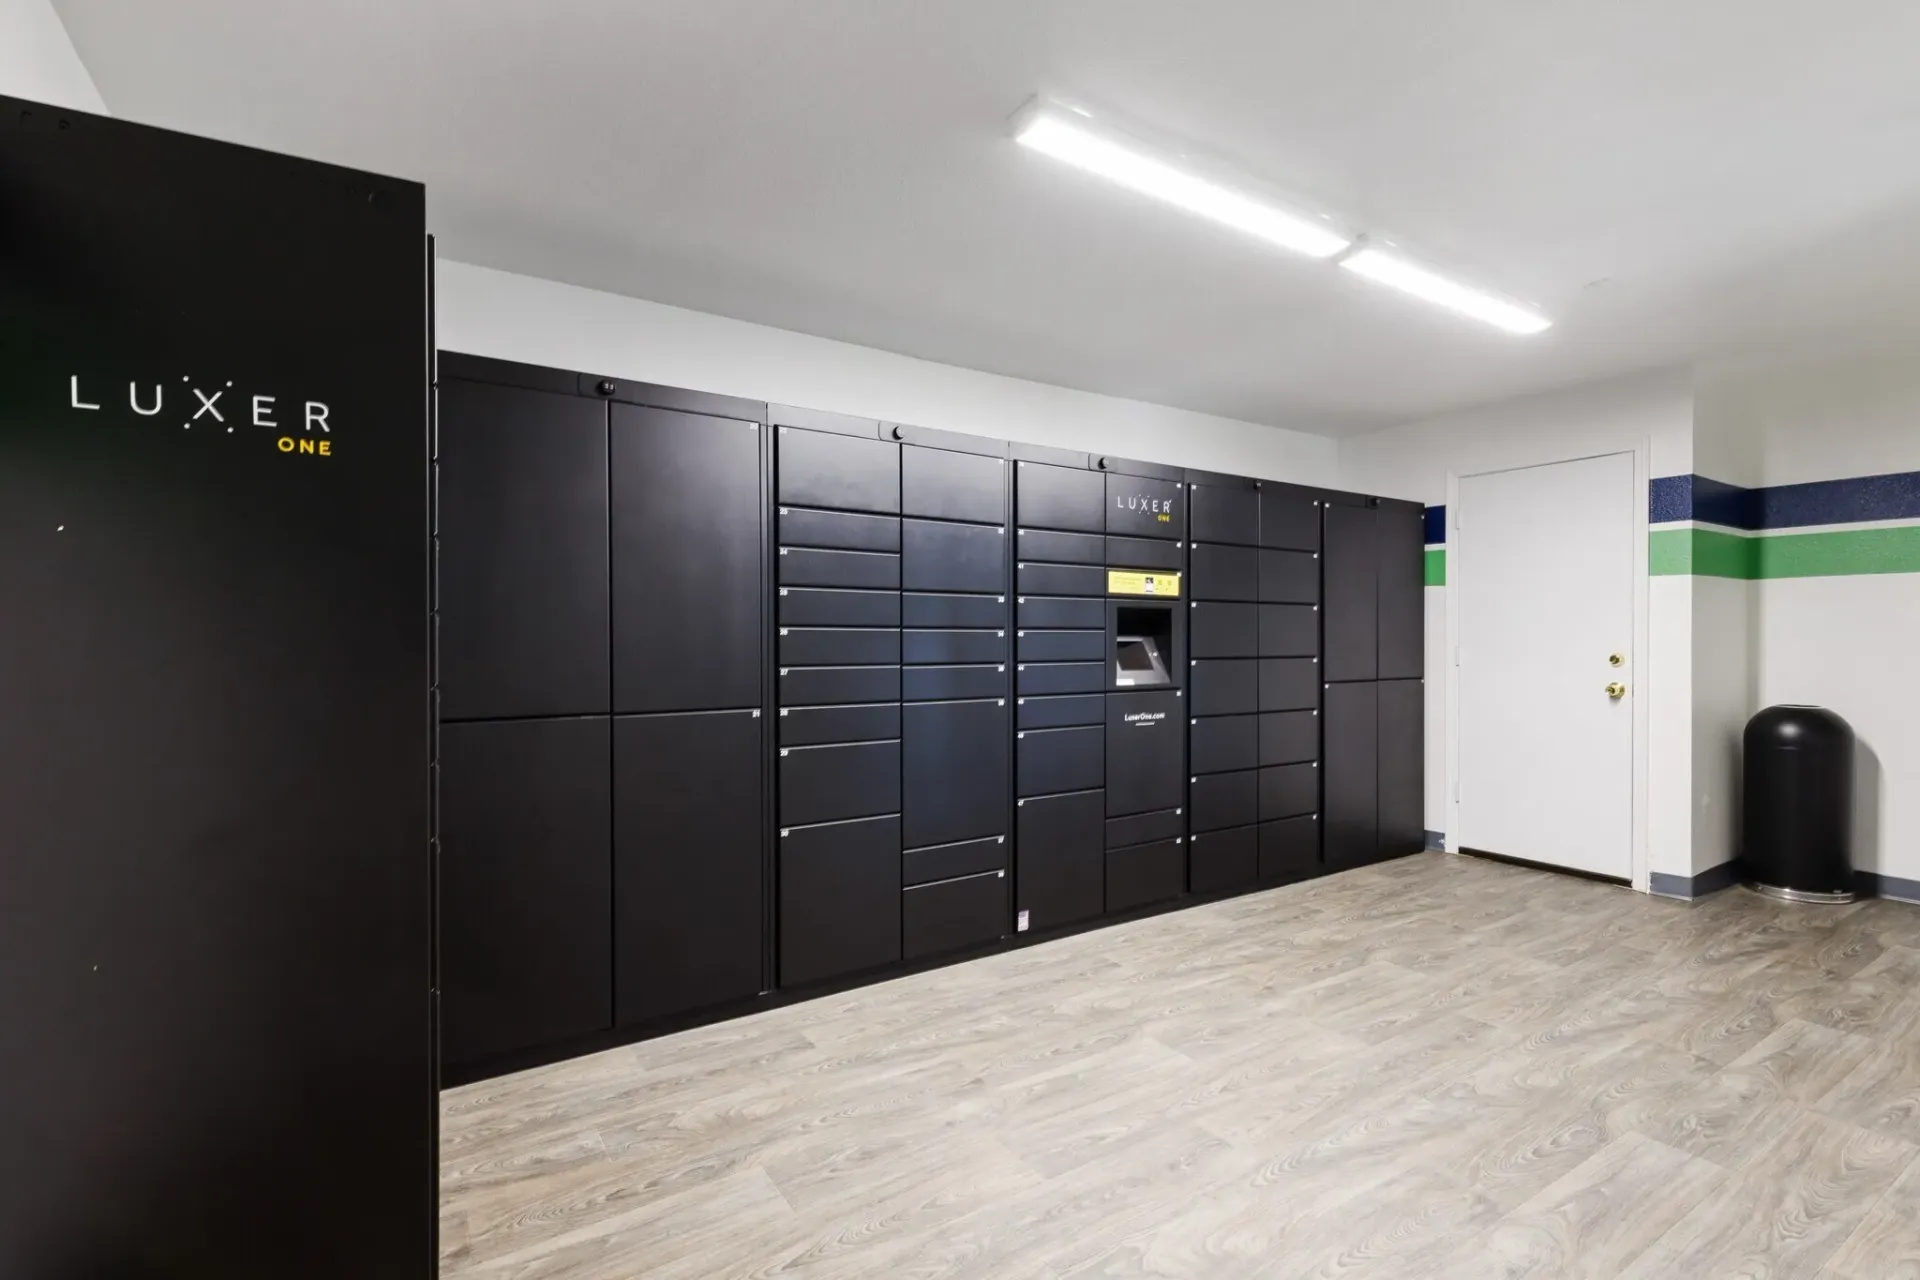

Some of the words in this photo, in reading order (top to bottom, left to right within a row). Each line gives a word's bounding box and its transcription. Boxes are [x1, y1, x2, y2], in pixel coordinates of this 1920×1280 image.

[71, 375, 331, 433] LUXER
[278, 437, 331, 455] ONE
[1117, 494, 1170, 514] LUXER
